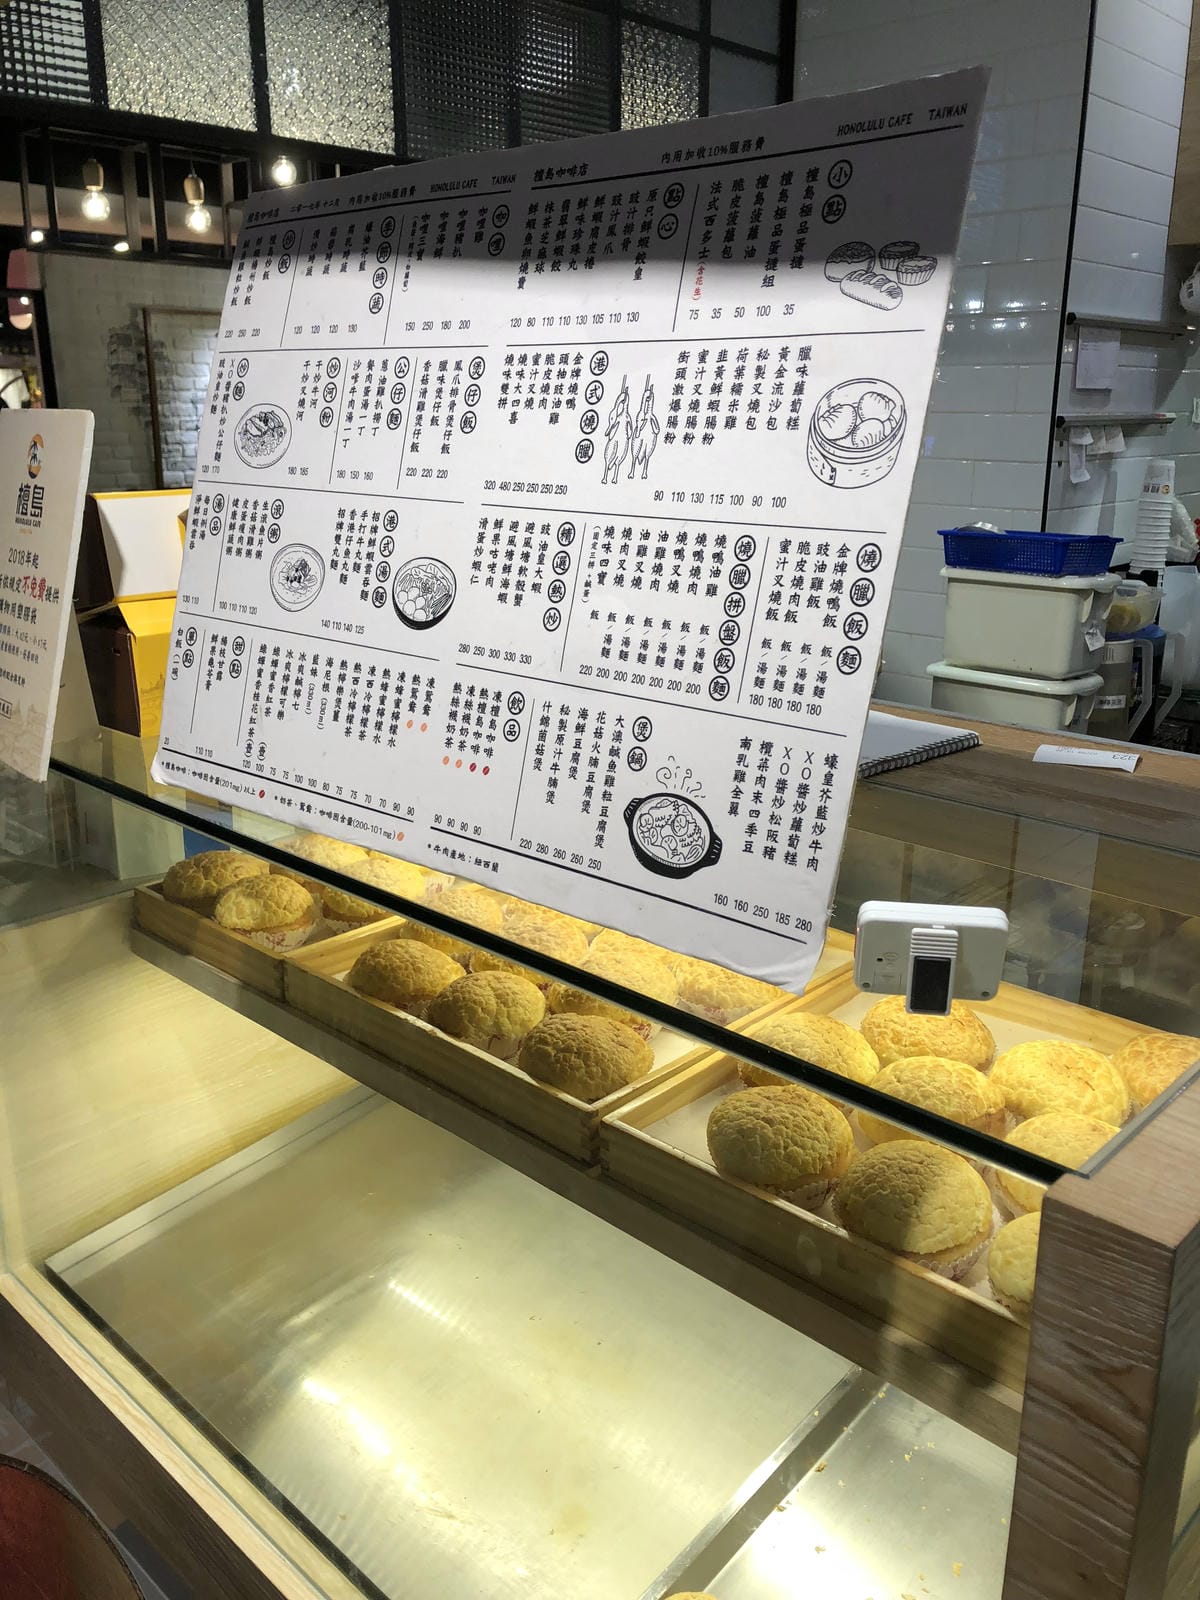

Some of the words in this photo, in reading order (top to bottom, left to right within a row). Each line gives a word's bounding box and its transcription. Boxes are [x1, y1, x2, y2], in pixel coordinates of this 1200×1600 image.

[837, 118, 887, 138] HONOLULU
[888, 113, 913, 128] CAFE
[929, 103, 968, 120] TAIWAN
[492, 174, 516, 185] TAIWAN
[662, 136, 768, 166] 內用加收10%服務費
[462, 179, 478, 189] CAFE
[659, 184, 683, 238] 點心
[823, 161, 852, 223] 小點
[698, 180, 722, 259] 法式西多士
[510, 318, 522, 328] 120
[527, 317, 536, 327] 80
[542, 316, 554, 327] 110
[559, 316, 570, 326] 110
[576, 314, 588, 325] 130
[592, 314, 604, 324] 105
[609, 313, 621, 323] 110
[627, 312, 640, 323] 130
[688, 309, 699, 320] 75
[711, 307, 722, 319] 35
[734, 307, 745, 318] 50
[755, 305, 771, 317] 100
[783, 304, 795, 316] 35
[462, 358, 484, 432] 煲仔飯
[498, 354, 514, 409] 燒味雙拼
[509, 354, 527, 424] 燒味大四喜
[524, 353, 541, 410] 蜜汁叉燒
[538, 353, 555, 409] 脆皮燒肉
[549, 353, 570, 424] 頭抽豉油雞
[566, 352, 583, 410] 金牌燒鴨
[683, 349, 709, 444] 蜜汁叉燒腸粉
[702, 349, 728, 445] 韭黃鮮蝦腸粉
[724, 347, 749, 430] 荷葉糯米雞
[746, 348, 770, 430] 秘製叉燒包
[766, 346, 790, 430] 黃金流沙包
[406, 468, 417, 477] 220
[421, 469, 433, 478] 220
[437, 470, 448, 478] 220
[484, 480, 496, 490] 320
[499, 481, 511, 491] 480
[512, 481, 525, 492] 250
[527, 482, 539, 492] 250
[540, 483, 553, 494] 250
[554, 484, 567, 495] 250
[654, 490, 664, 501] 90
[672, 491, 685, 502] 110
[690, 492, 704, 503] 130
[710, 493, 724, 504] 115
[730, 494, 744, 506] 100
[752, 496, 762, 506] 90
[771, 496, 786, 508] 100
[8, 547, 39, 569] 2018年起
[544, 523, 574, 630] 精選熱炒
[597, 526, 615, 585] 燒味四寶
[613, 527, 632, 587] 燒肉叉燒
[631, 529, 650, 590] 油雞叉燒
[650, 531, 669, 592] 油雞燒肉
[667, 531, 687, 593] 燒鴨叉燒
[687, 533, 707, 595] 燒鴨燒肉
[705, 534, 727, 597] 燒鴨油雞
[766, 539, 792, 621] 蜜汁叉燒飯
[784, 541, 811, 623] 脆皮燒肉飯
[807, 542, 830, 608] 豉油雞飯
[823, 543, 851, 628] 金牌燒鴨飯
[459, 643, 470, 654] 280
[474, 646, 485, 656] 250
[488, 648, 500, 659] 300
[504, 651, 516, 662] 330
[519, 654, 532, 664] 330
[579, 665, 592, 676] 220
[596, 668, 609, 678] 200
[613, 671, 627, 681] 200
[631, 674, 645, 684] 200
[649, 677, 663, 688] 200
[667, 680, 682, 691] 200
[686, 684, 701, 695] 200
[504, 692, 524, 741] 飲品
[749, 694, 763, 706] 180
[768, 697, 783, 709] 180
[787, 700, 802, 712] 180
[806, 704, 822, 716] 180
[545, 704, 570, 804] 秘製原汁牛腩煲
[568, 708, 589, 780] 海鮮豆腐煲
[629, 717, 651, 770] 煲鍋
[728, 736, 752, 817] 南乳雞全翼
[742, 740, 773, 853] 欖菜肉末四季豆
[762, 747, 792, 860] XO醬炒松阪豬
[434, 814, 442, 824] 90
[447, 818, 455, 827] 90
[460, 822, 468, 831] 90
[473, 826, 481, 835] 90
[807, 754, 838, 872] 蠔皇芥藍炒牛肉
[520, 838, 532, 850] 220
[536, 843, 549, 855] 280
[553, 848, 566, 860] 260
[570, 853, 583, 865] 260
[588, 858, 601, 870] 250
[714, 893, 728, 906] 160
[734, 899, 749, 912] 160
[753, 905, 769, 919] 250
[775, 912, 790, 925] 185
[796, 918, 812, 932] 280
